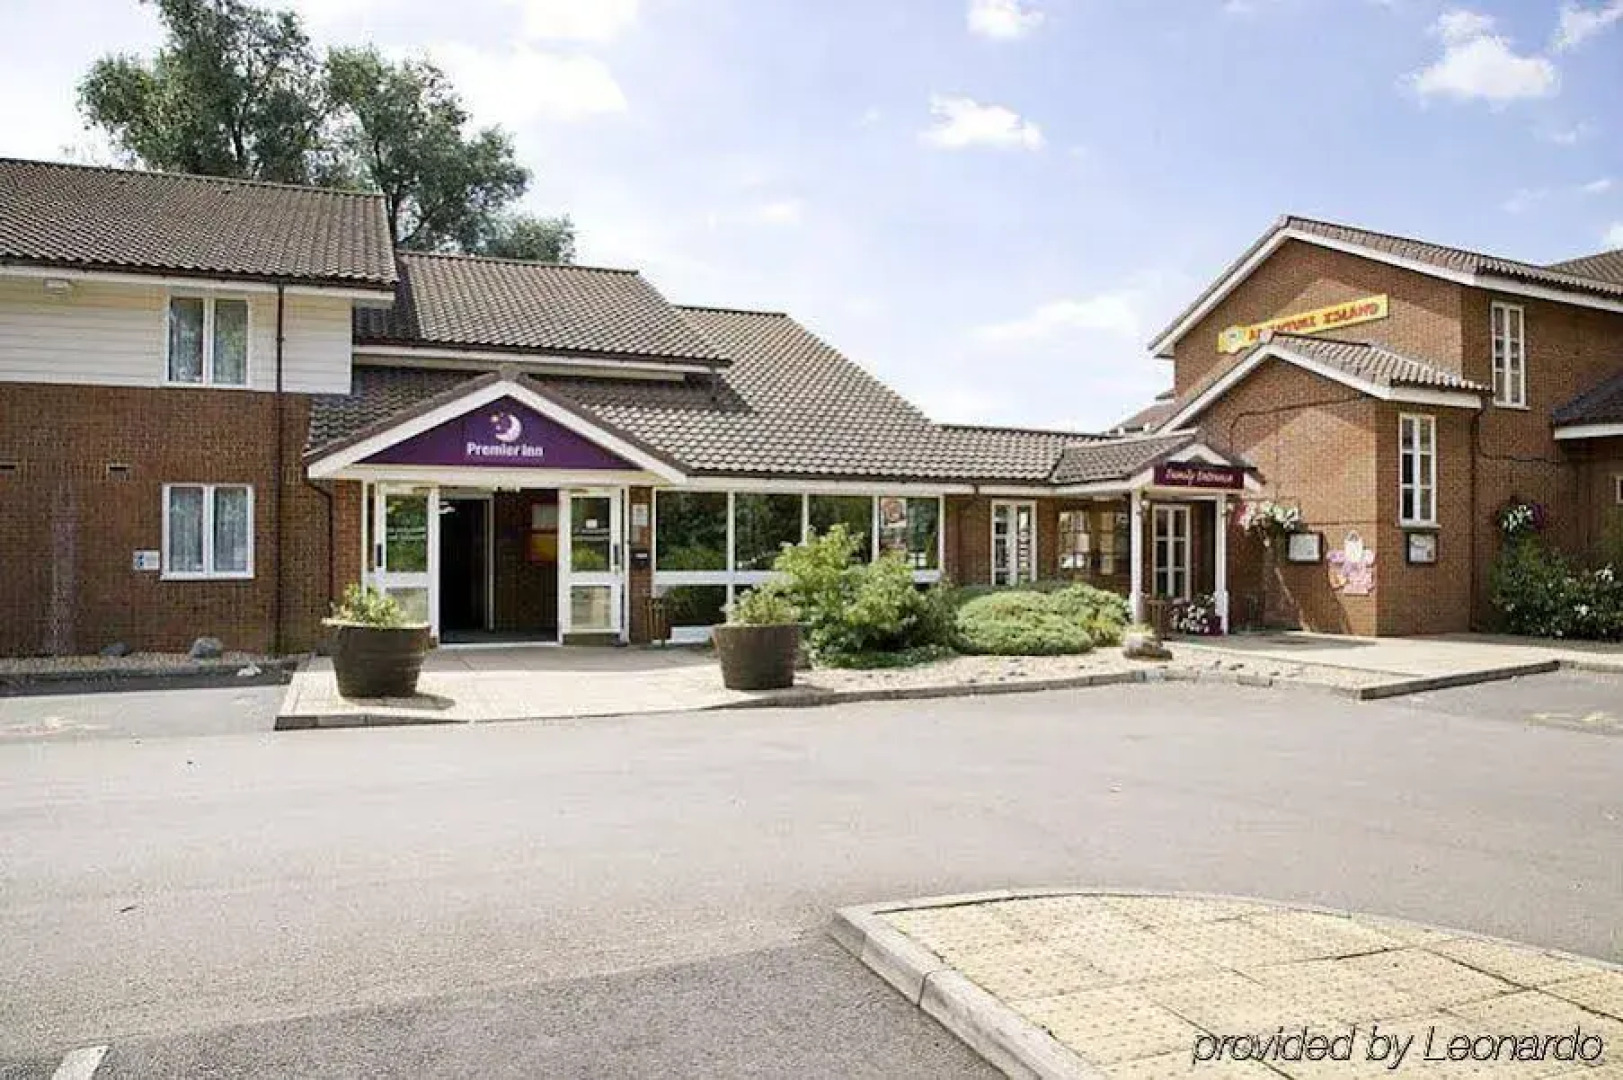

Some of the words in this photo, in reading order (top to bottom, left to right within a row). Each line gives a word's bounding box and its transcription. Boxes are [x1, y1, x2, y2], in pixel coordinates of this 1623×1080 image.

[1323, 302, 1379, 325] ISLAND
[466, 441, 520, 456] Premier
[522, 443, 544, 457] Inn
